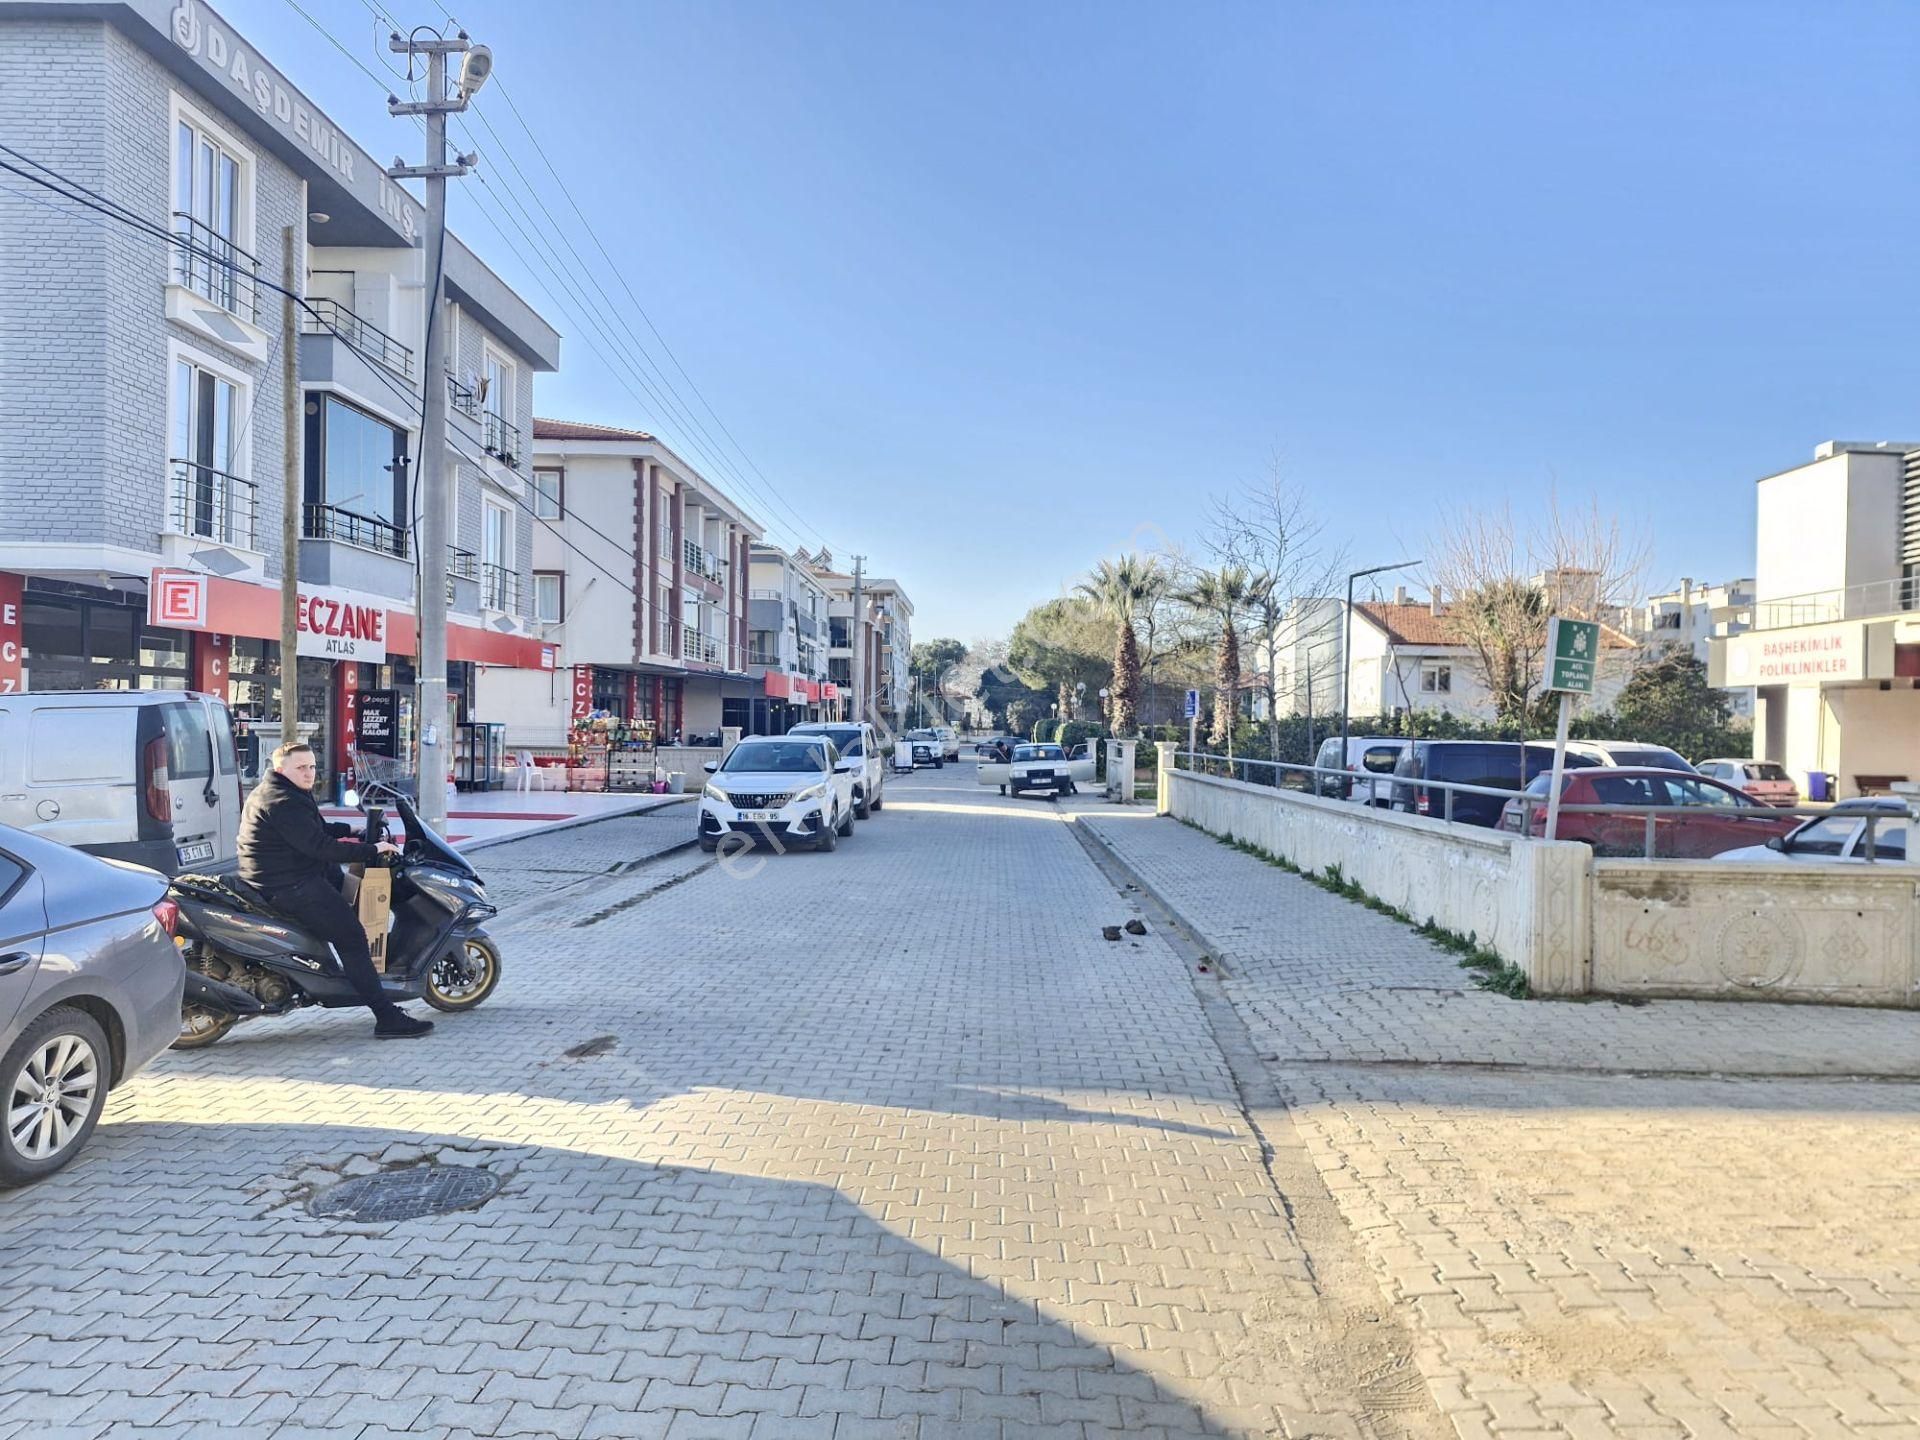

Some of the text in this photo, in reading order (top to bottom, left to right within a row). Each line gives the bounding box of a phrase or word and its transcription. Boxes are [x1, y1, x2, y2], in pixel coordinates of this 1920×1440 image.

[207, 24, 354, 184] DAŞDEMİR
[170, 587, 190, 613] E
[296, 594, 383, 643] ECZANE
[325, 639, 355, 655] ATLAS
[1763, 636, 1842, 658] BAŞHEKİMLİK
